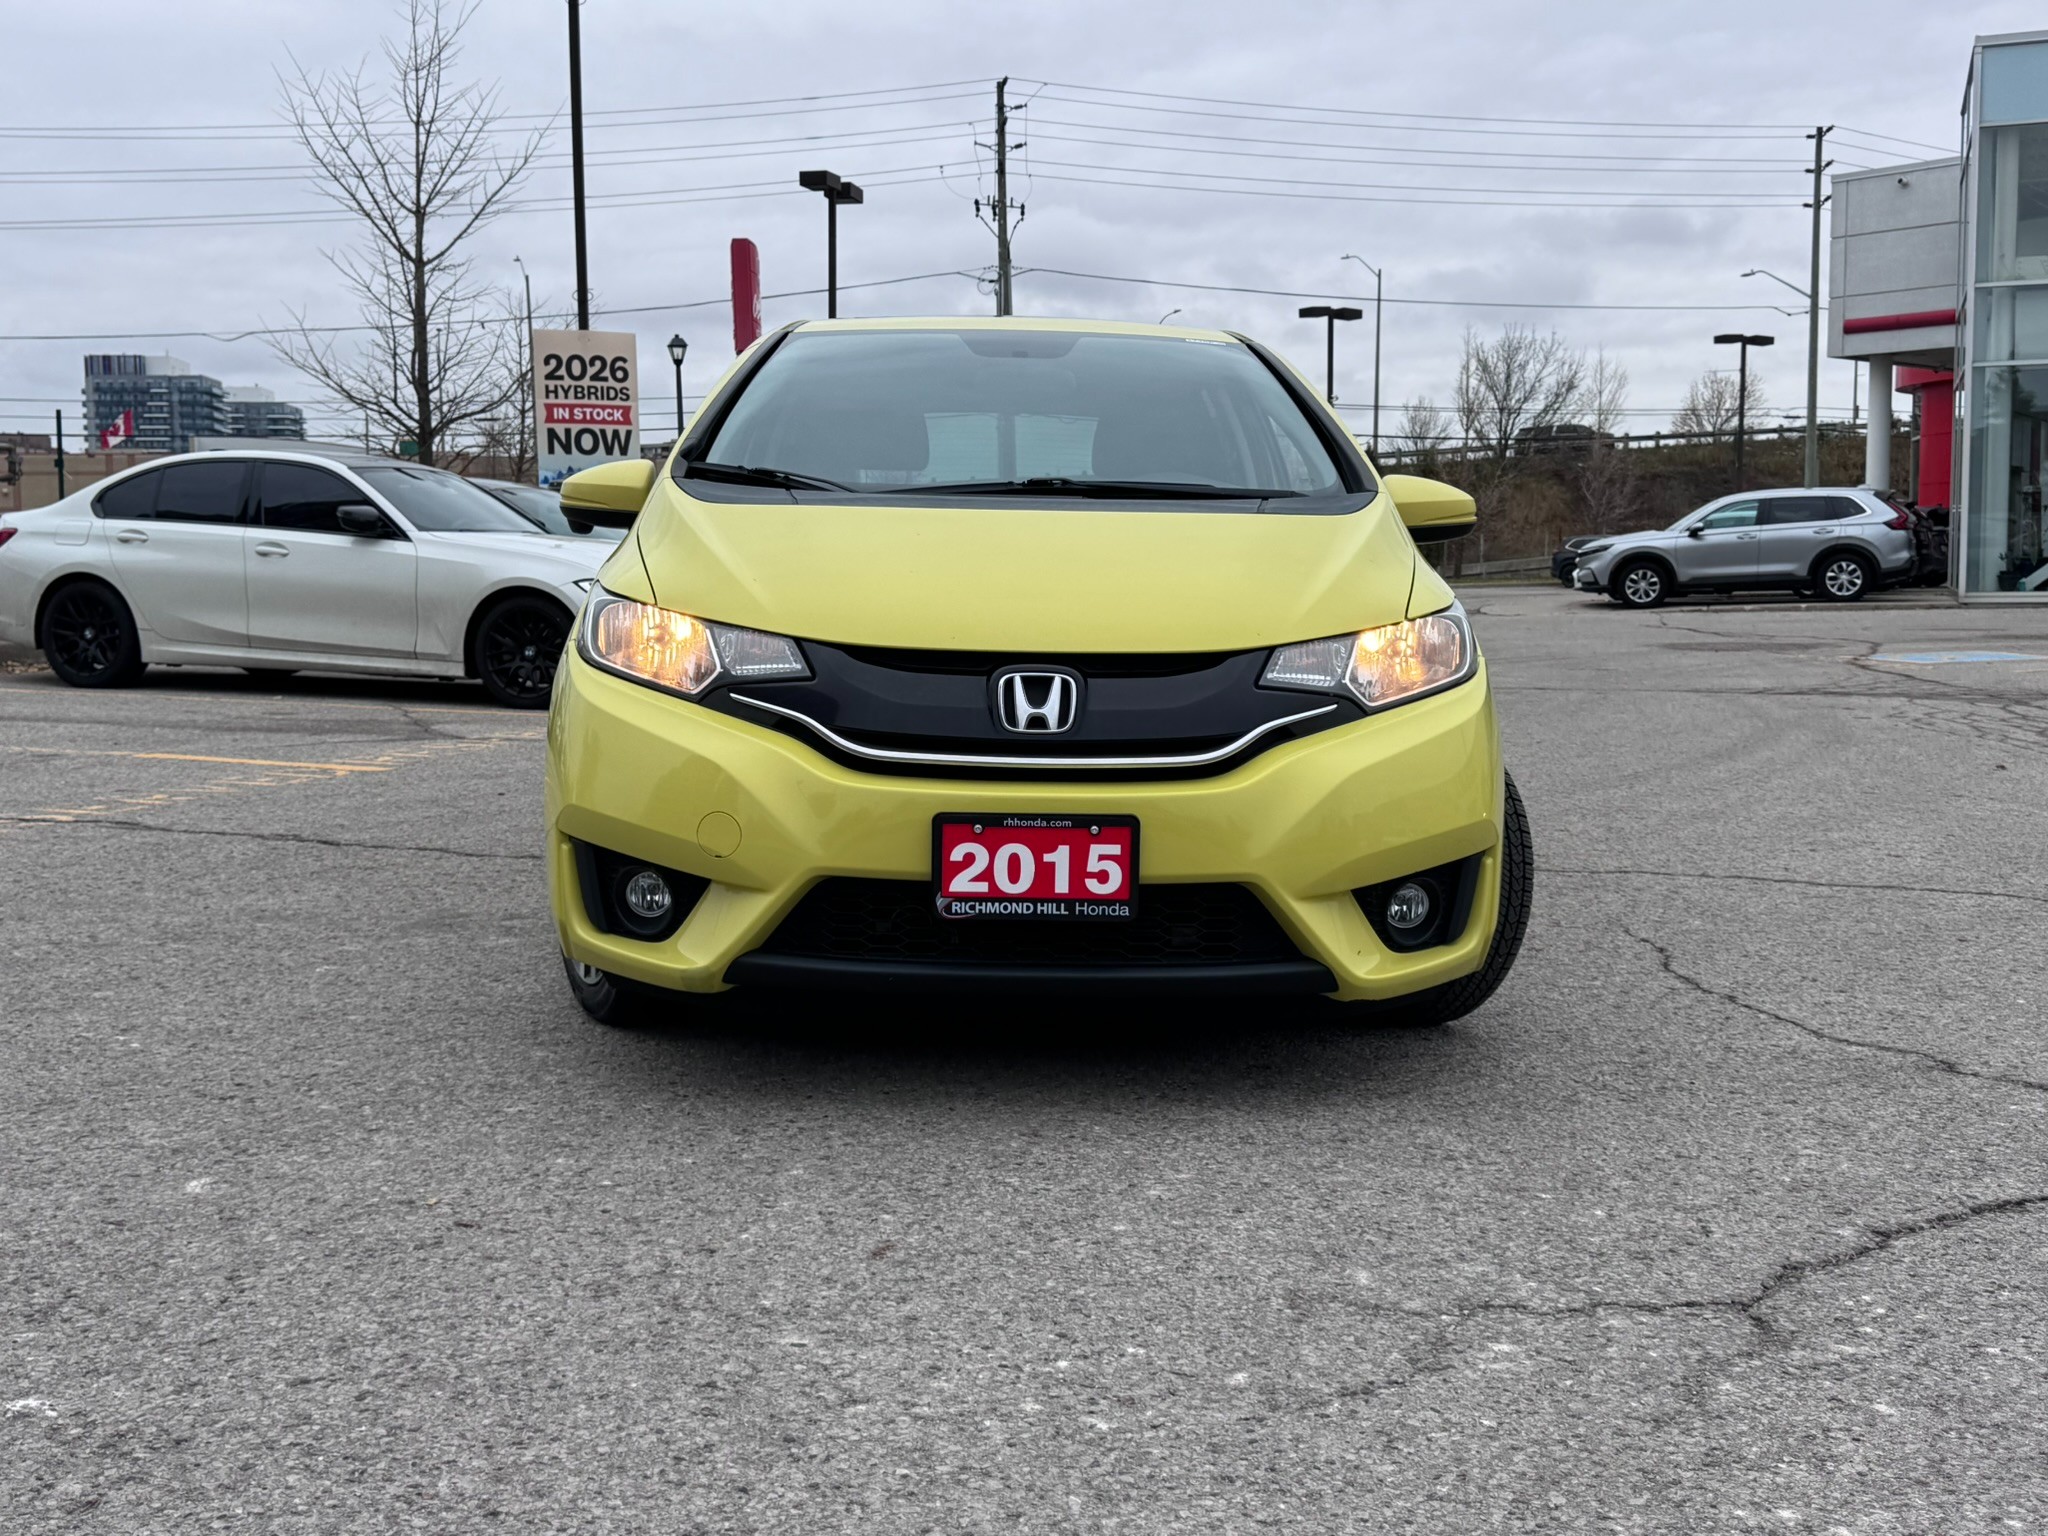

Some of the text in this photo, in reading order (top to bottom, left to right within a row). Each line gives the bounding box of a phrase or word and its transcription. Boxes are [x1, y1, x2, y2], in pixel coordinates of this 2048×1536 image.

[543, 353, 630, 383] 2026
[544, 384, 630, 402] HYBRIDS
[553, 407, 624, 422] IN STOCK
[546, 427, 633, 457] NOW
[1003, 818, 1072, 828] rhhonda.com
[948, 842, 1123, 895] 2015
[951, 902, 1130, 916] RICHMOND HILL Honda
